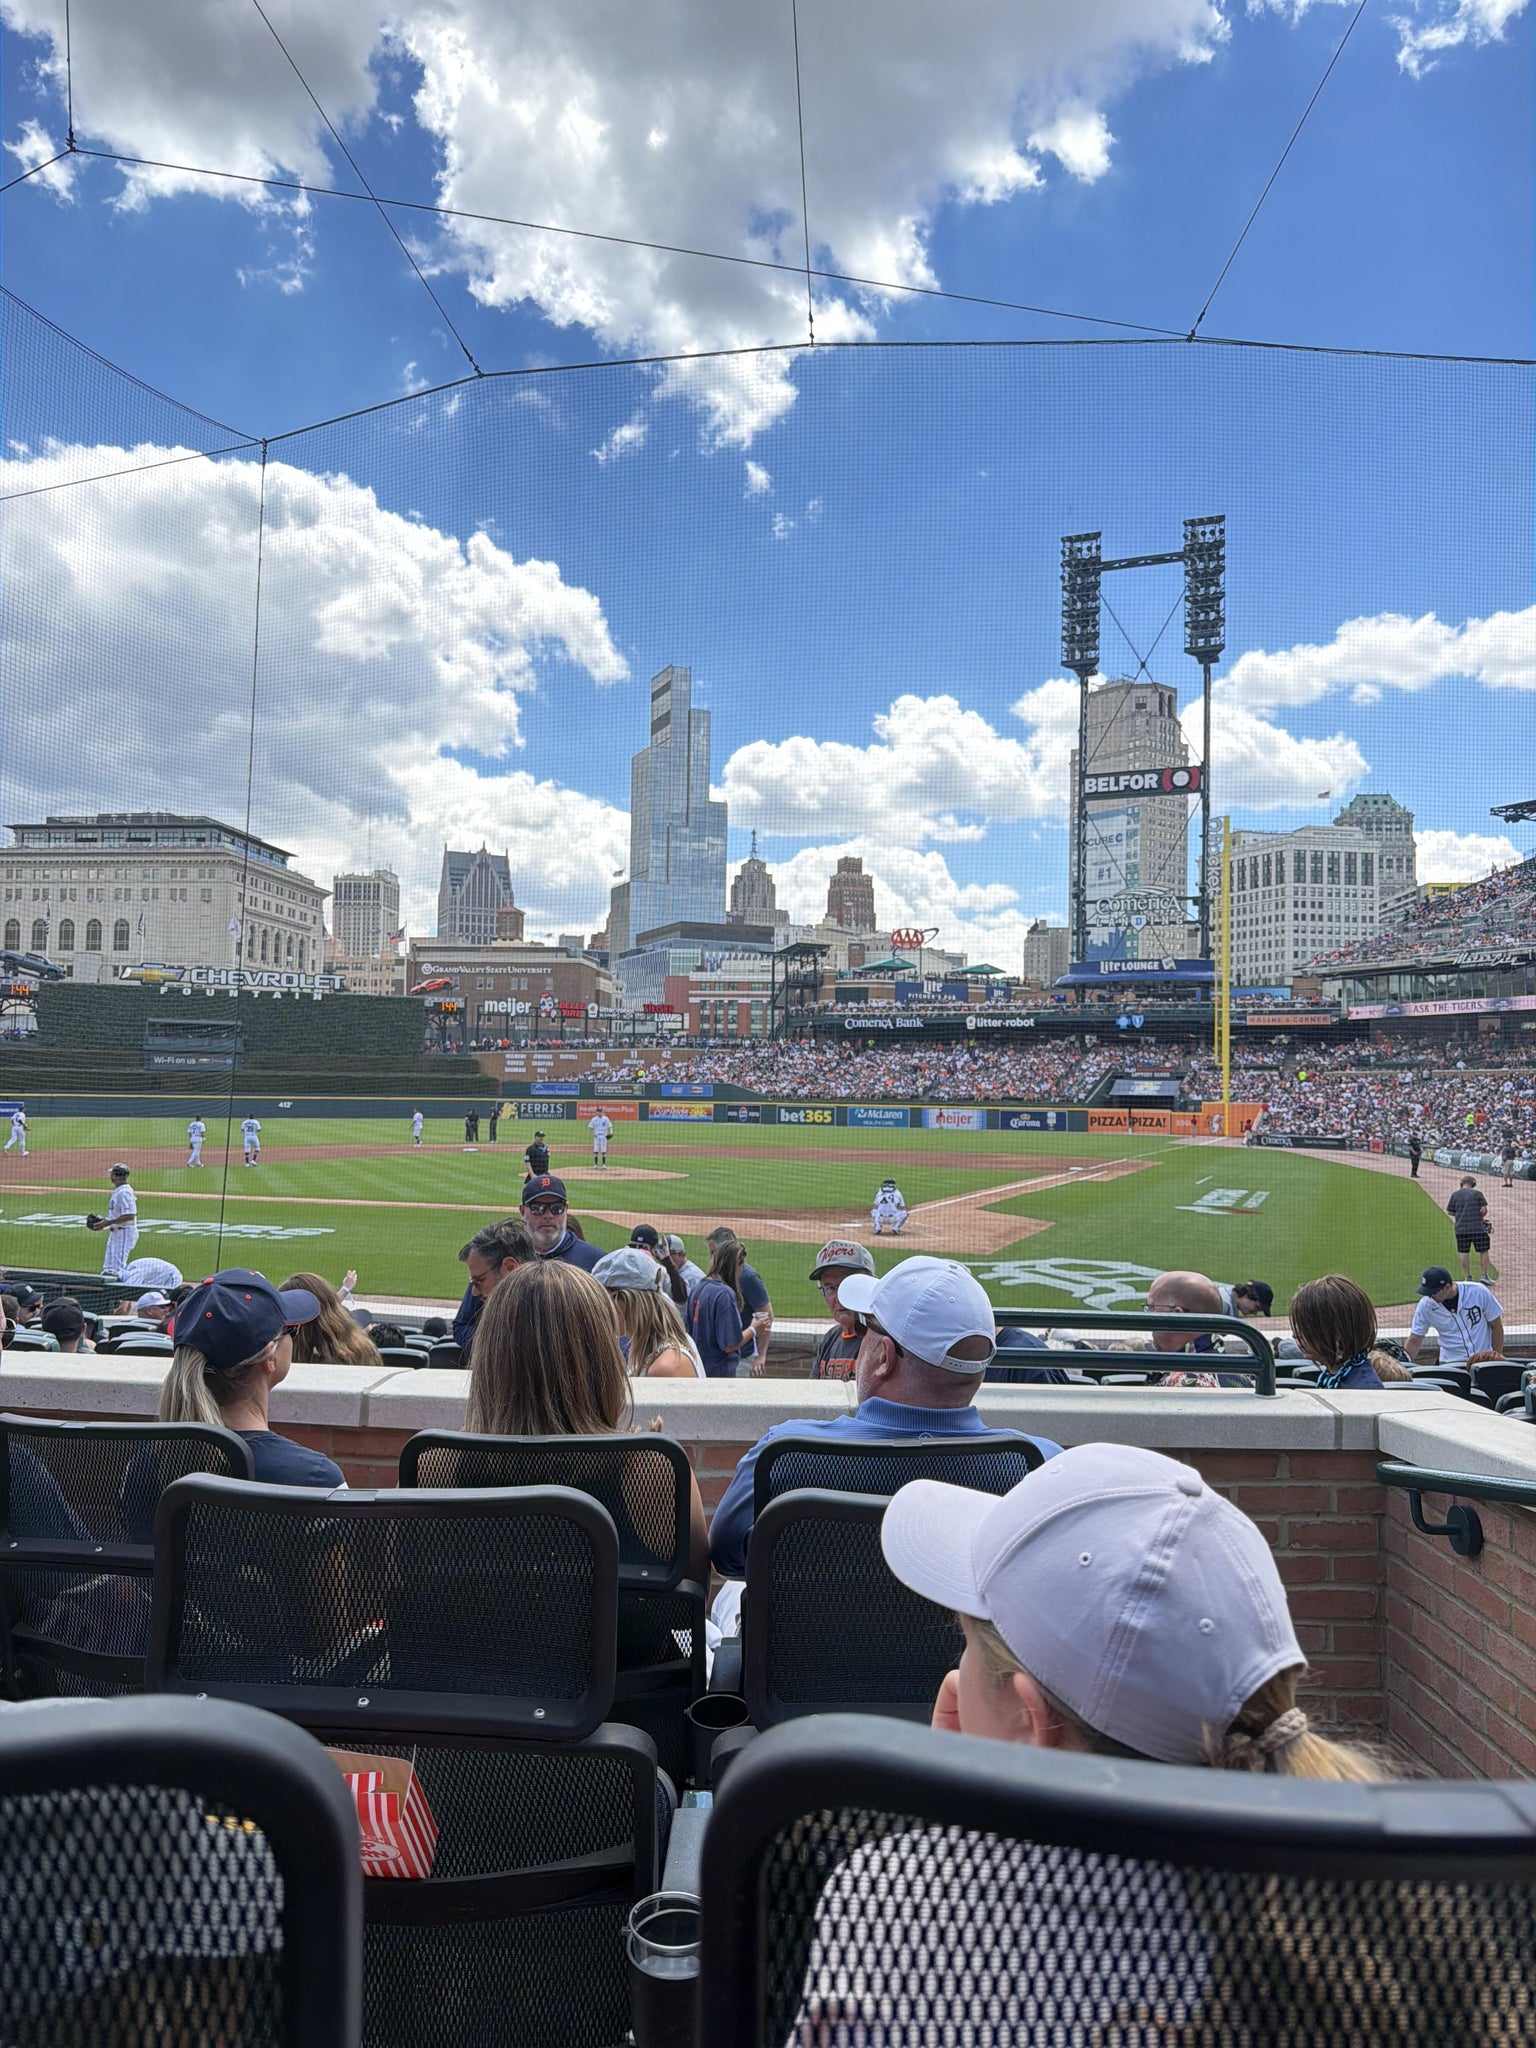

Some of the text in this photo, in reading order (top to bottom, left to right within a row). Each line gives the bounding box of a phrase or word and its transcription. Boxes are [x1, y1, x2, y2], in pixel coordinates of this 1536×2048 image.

[1084, 773, 1158, 793] BELFOR
[1207, 834, 1222, 895] Rocket
[1097, 866, 1111, 880] #1
[893, 929, 922, 948] AAA
[433, 966, 553, 974] GRAND VALLEY STATE UNIVERSITY
[1101, 960, 1159, 974] Lite LOUNGE
[190, 968, 346, 989] CHEVROLET
[923, 980, 943, 995] Lite
[485, 998, 532, 1016] meijer
[558, 1002, 586, 1010] BELLE
[1413, 1000, 1483, 1013] ASK THE TIGERS
[655, 1013, 673, 1022] LAW
[895, 1017, 924, 1028] Bank
[976, 1015, 1035, 1028] litter-robot
[154, 1056, 175, 1064] Wi-Fi
[596, 1052, 606, 1061] 10
[630, 1050, 638, 1059] 11
[661, 1050, 672, 1059] 42
[520, 1103, 563, 1114] FERRIS
[867, 1109, 903, 1119] McLaren
[780, 1108, 832, 1123] bet365
[935, 1111, 973, 1127] meijer
[1089, 1116, 1166, 1128] PIZZA! PIZZA!
[1009, 1117, 1041, 1128] Corona
[541, 1177, 551, 1188] D
[819, 1247, 856, 1263] Tigers
[1462, 1304, 1482, 1329] D
